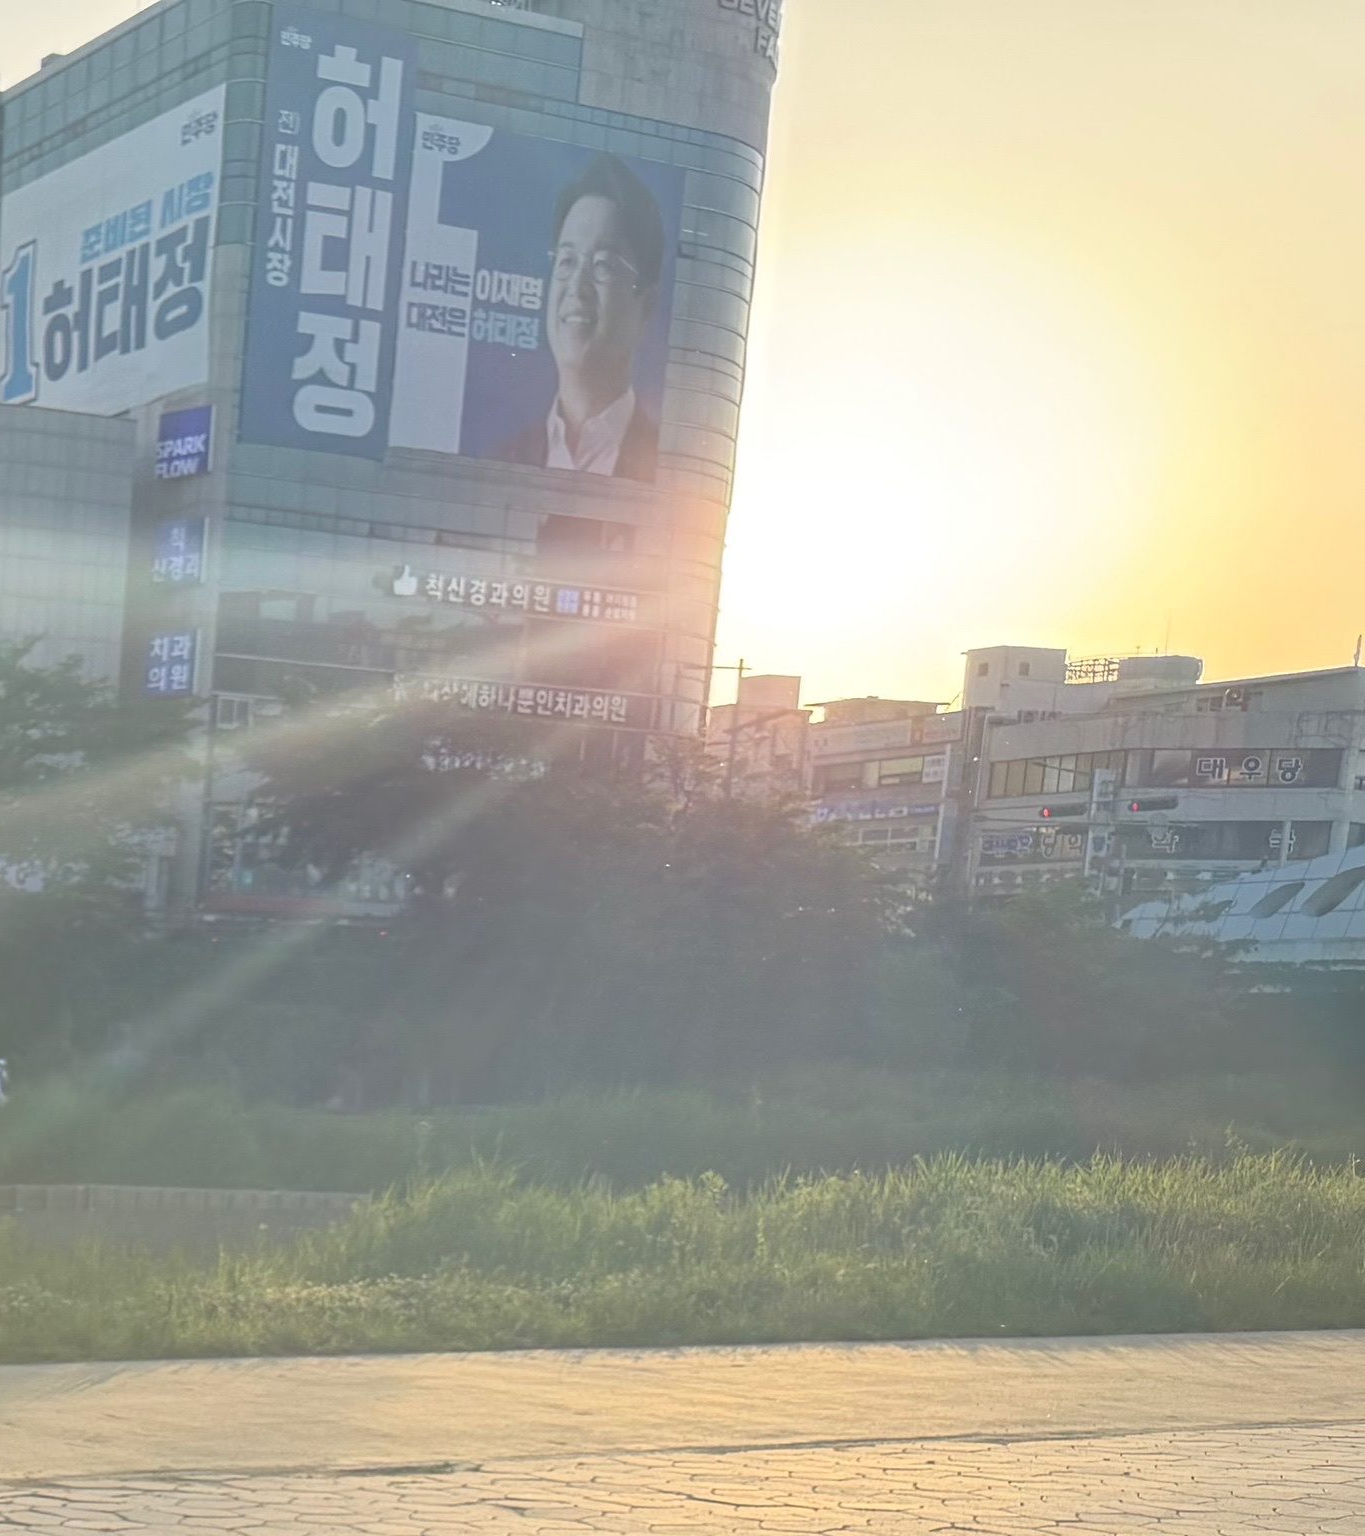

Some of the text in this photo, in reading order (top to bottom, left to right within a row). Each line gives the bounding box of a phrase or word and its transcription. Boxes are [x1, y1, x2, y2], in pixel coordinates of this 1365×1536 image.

[180, 109, 219, 147] 민주당
[421, 131, 461, 155] 민주당
[80, 171, 214, 264] 준비된 시장
[266, 143, 300, 287] 대전시장
[291, 44, 404, 438] 허태정
[42, 215, 211, 382] 허태정
[409, 260, 544, 311] 나라는 이재명
[406, 301, 540, 350] 대전은 허태정
[156, 433, 207, 460] SPARK
[155, 456, 201, 480] FLOW
[151, 553, 200, 583] 신경과
[149, 634, 192, 662] 치과
[147, 664, 189, 692] 의원
[1196, 756, 1303, 784] 대우당
